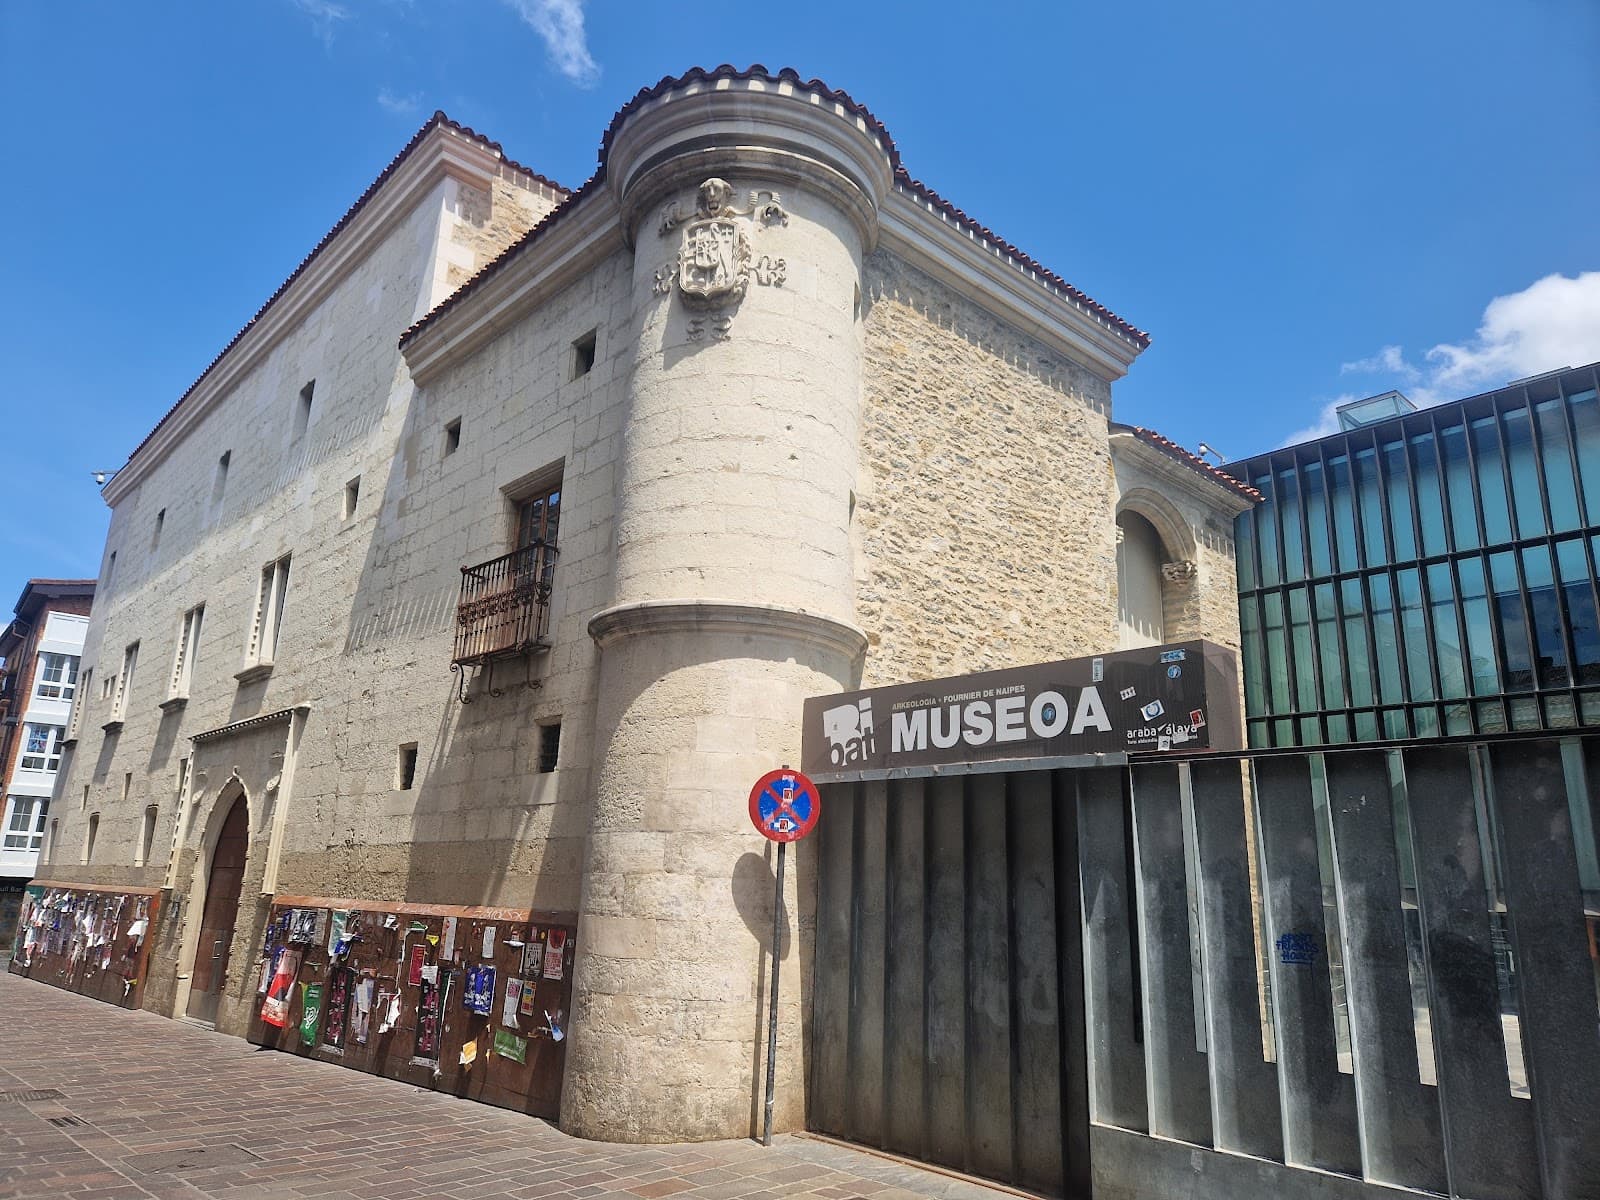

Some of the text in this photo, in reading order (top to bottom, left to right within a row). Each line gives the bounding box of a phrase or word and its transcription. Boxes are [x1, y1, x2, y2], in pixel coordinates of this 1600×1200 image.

[892, 684, 1026, 711] ARKEOLOGIA FOURNIER DE NAIPES
[891, 685, 1113, 753] MUSEOA
[1127, 725, 1157, 739] araba
